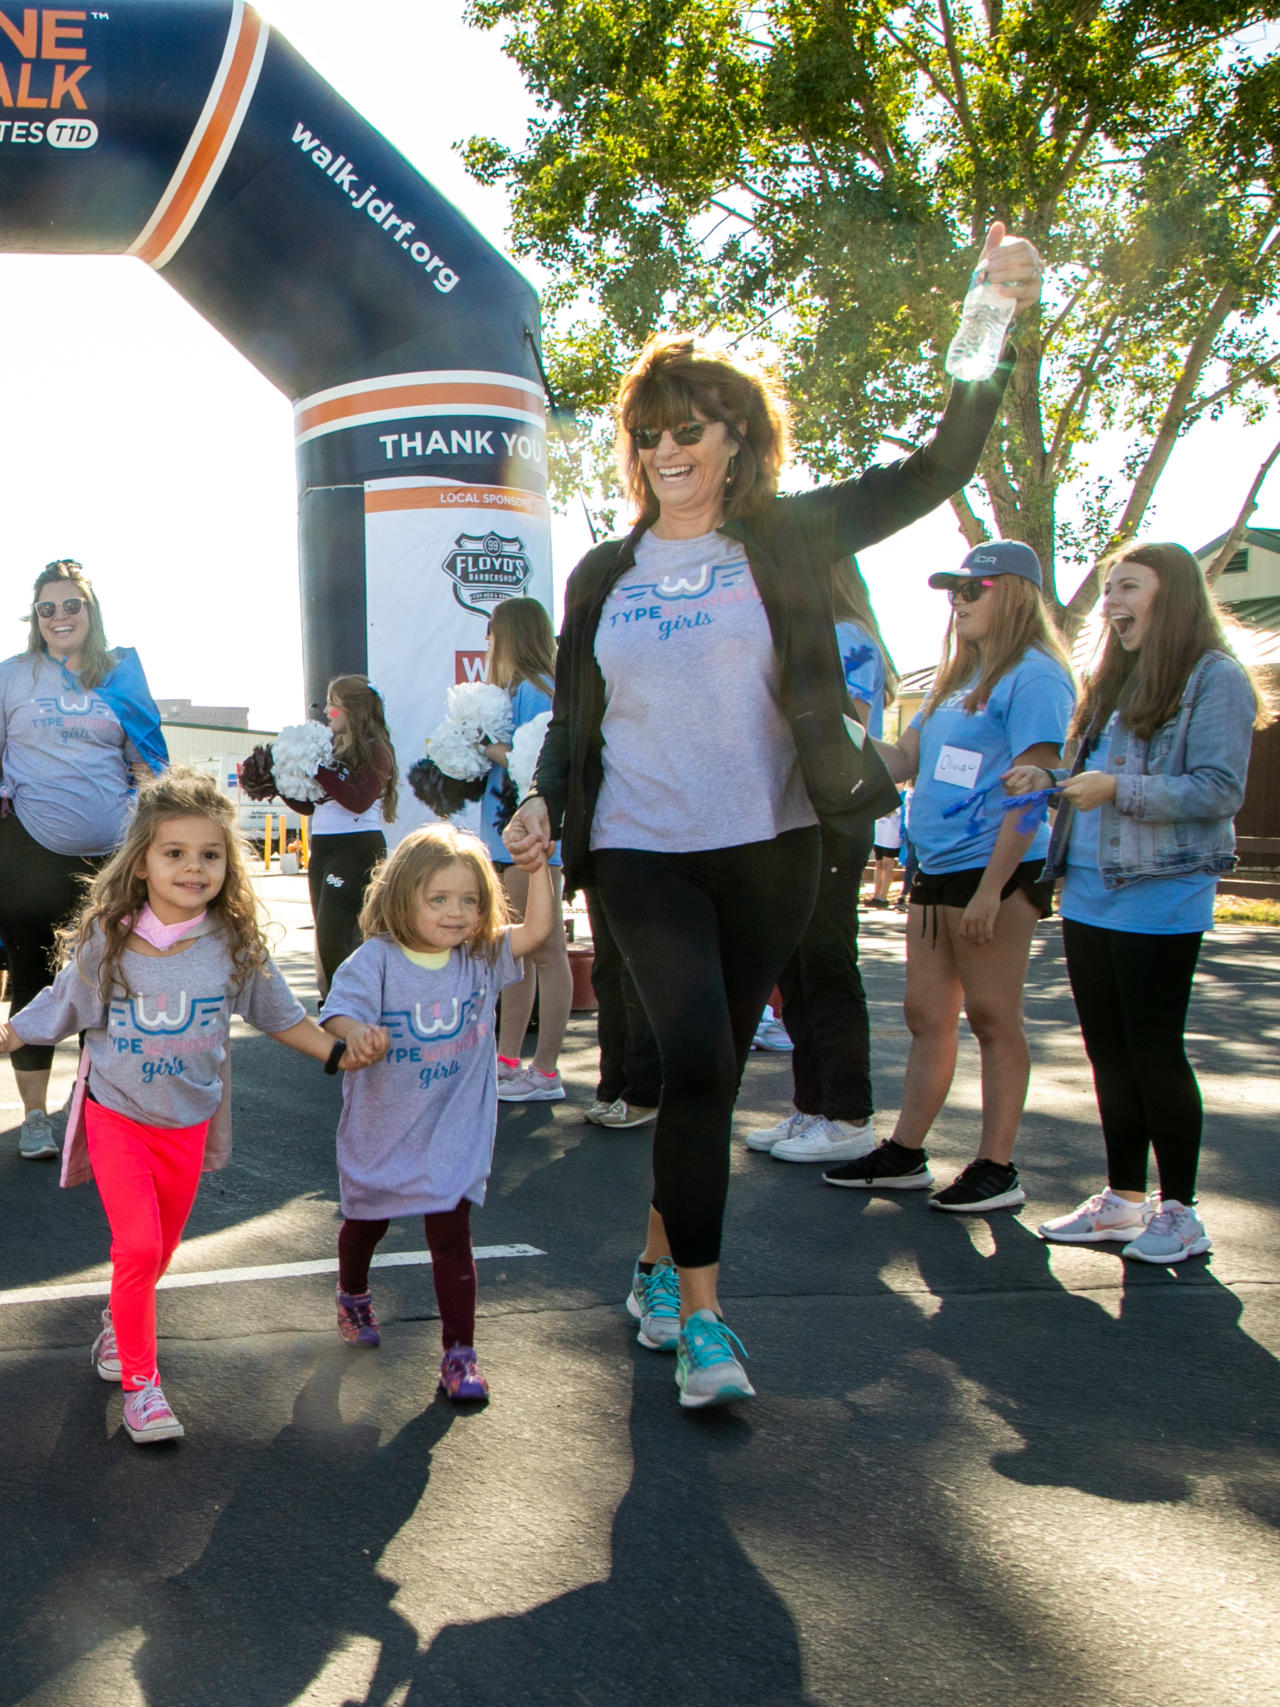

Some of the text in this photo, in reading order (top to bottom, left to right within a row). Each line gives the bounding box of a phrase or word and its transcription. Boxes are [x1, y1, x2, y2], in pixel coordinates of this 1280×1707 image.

[291, 122, 460, 293] walk.jdrf.org
[379, 430, 542, 463] THANK YOU
[440, 493, 479, 503] LOCAL
[456, 556, 524, 580] FLOYD'S
[469, 573, 517, 583] BARBERSHOP
[659, 611, 715, 641] girls
[419, 1059, 461, 1090] girls
